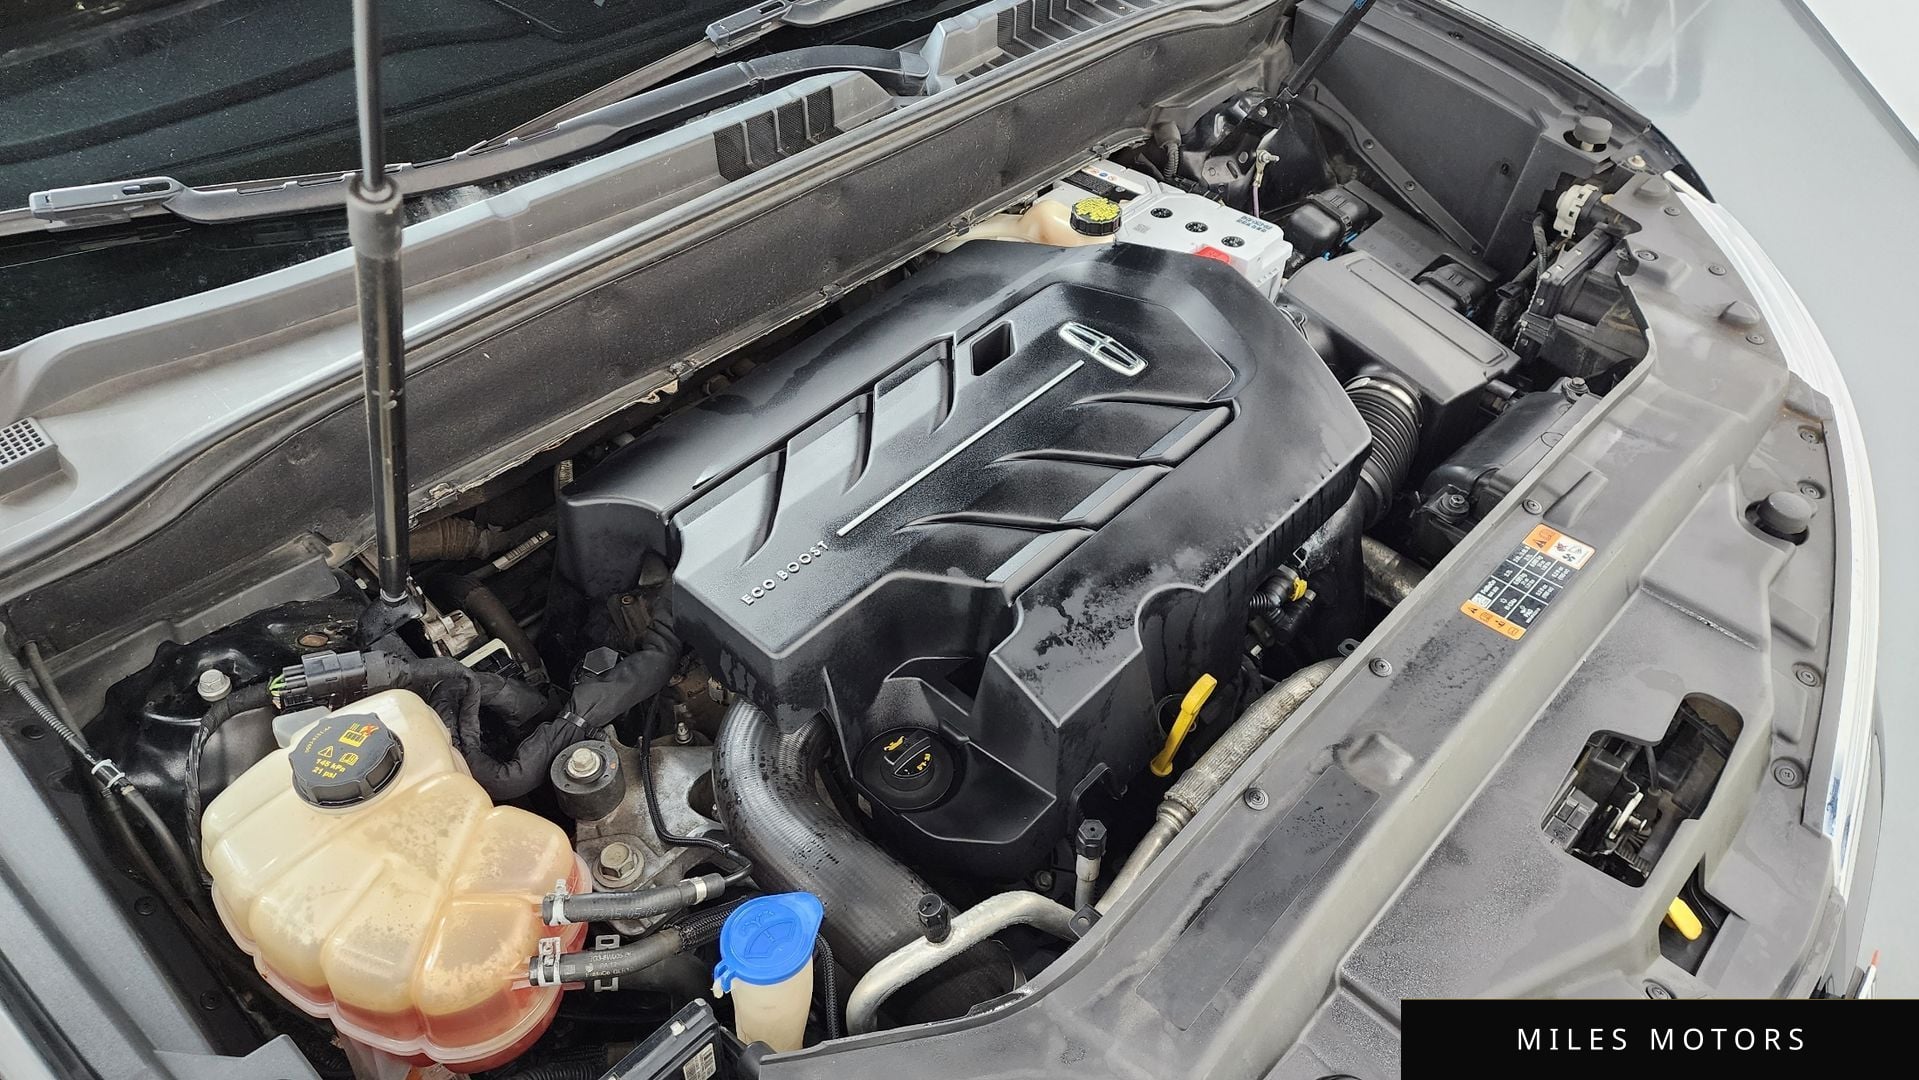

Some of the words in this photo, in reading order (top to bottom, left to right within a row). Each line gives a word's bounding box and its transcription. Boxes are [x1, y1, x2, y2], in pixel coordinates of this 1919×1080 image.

[740, 579, 776, 606] ECO
[777, 540, 828, 581] BOOST
[312, 766, 323, 774] 21
[316, 758, 331, 767] 145
[330, 763, 346, 772] kPa
